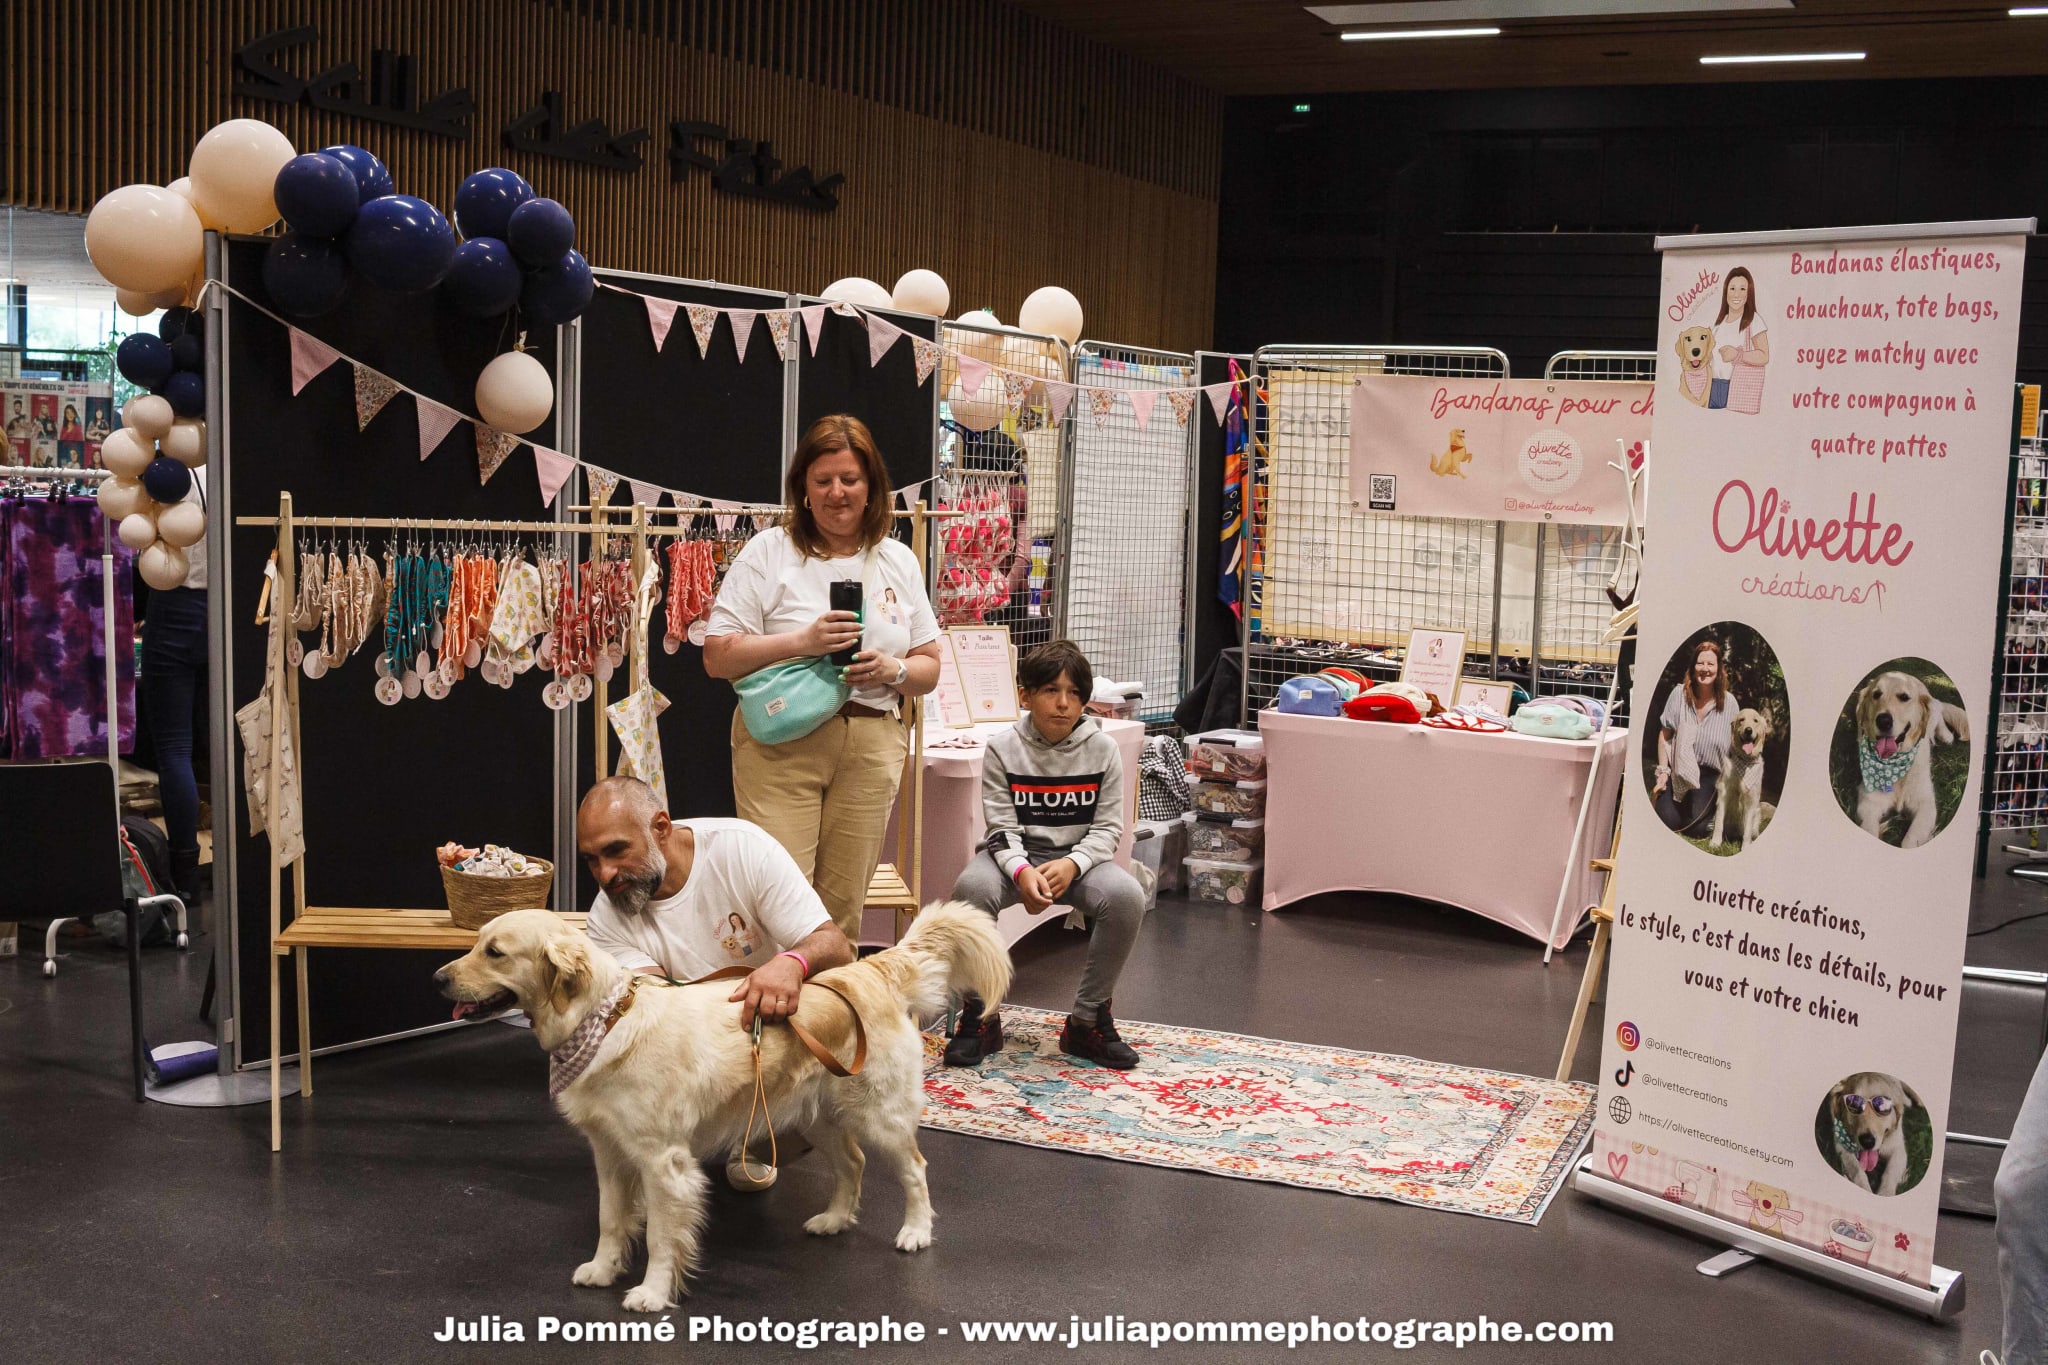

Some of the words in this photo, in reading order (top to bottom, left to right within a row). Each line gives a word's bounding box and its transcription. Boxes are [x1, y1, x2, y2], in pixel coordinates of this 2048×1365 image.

[1791, 251, 1883, 274] Bandanas
[1890, 248, 2000, 275] élastiques,
[1668, 268, 1719, 322] Olivette
[1786, 296, 1888, 319] chouchoux,
[1897, 295, 1937, 317] tote
[1945, 293, 1998, 323] bags,
[1797, 348, 1847, 369] soyez
[1855, 341, 1926, 371] matchy
[1934, 348, 1978, 365] avec
[1431, 384, 1551, 420] Bandanas
[1556, 398, 1621, 424] pour
[1793, 387, 1840, 408] votre
[1847, 394, 1956, 416] compagnon
[1965, 388, 1975, 410] à
[1811, 433, 1875, 458] quatre
[1882, 435, 1947, 462] pattes
[1712, 480, 1914, 566] Olivette
[1740, 570, 1863, 604] créations
[1694, 880, 1764, 914] Olivette
[1771, 901, 1865, 940] créations,
[1621, 904, 1633, 927] le
[1640, 913, 1685, 942] style,
[1693, 923, 1733, 950] c'est
[1739, 933, 1780, 962] dans
[1787, 943, 1812, 969] les
[1820, 951, 1891, 992] détails,
[1899, 976, 1946, 1001] pour
[1685, 970, 1723, 991] vous
[1730, 978, 1749, 998] et
[1754, 986, 1801, 1012] votre
[1809, 996, 1858, 1027] chien
[1645, 1036, 1732, 1070] @olivettecreations
[1641, 1073, 1728, 1107] @olivettecreations
[1638, 1110, 1794, 1168] https://olivettecreations.etsy.com
